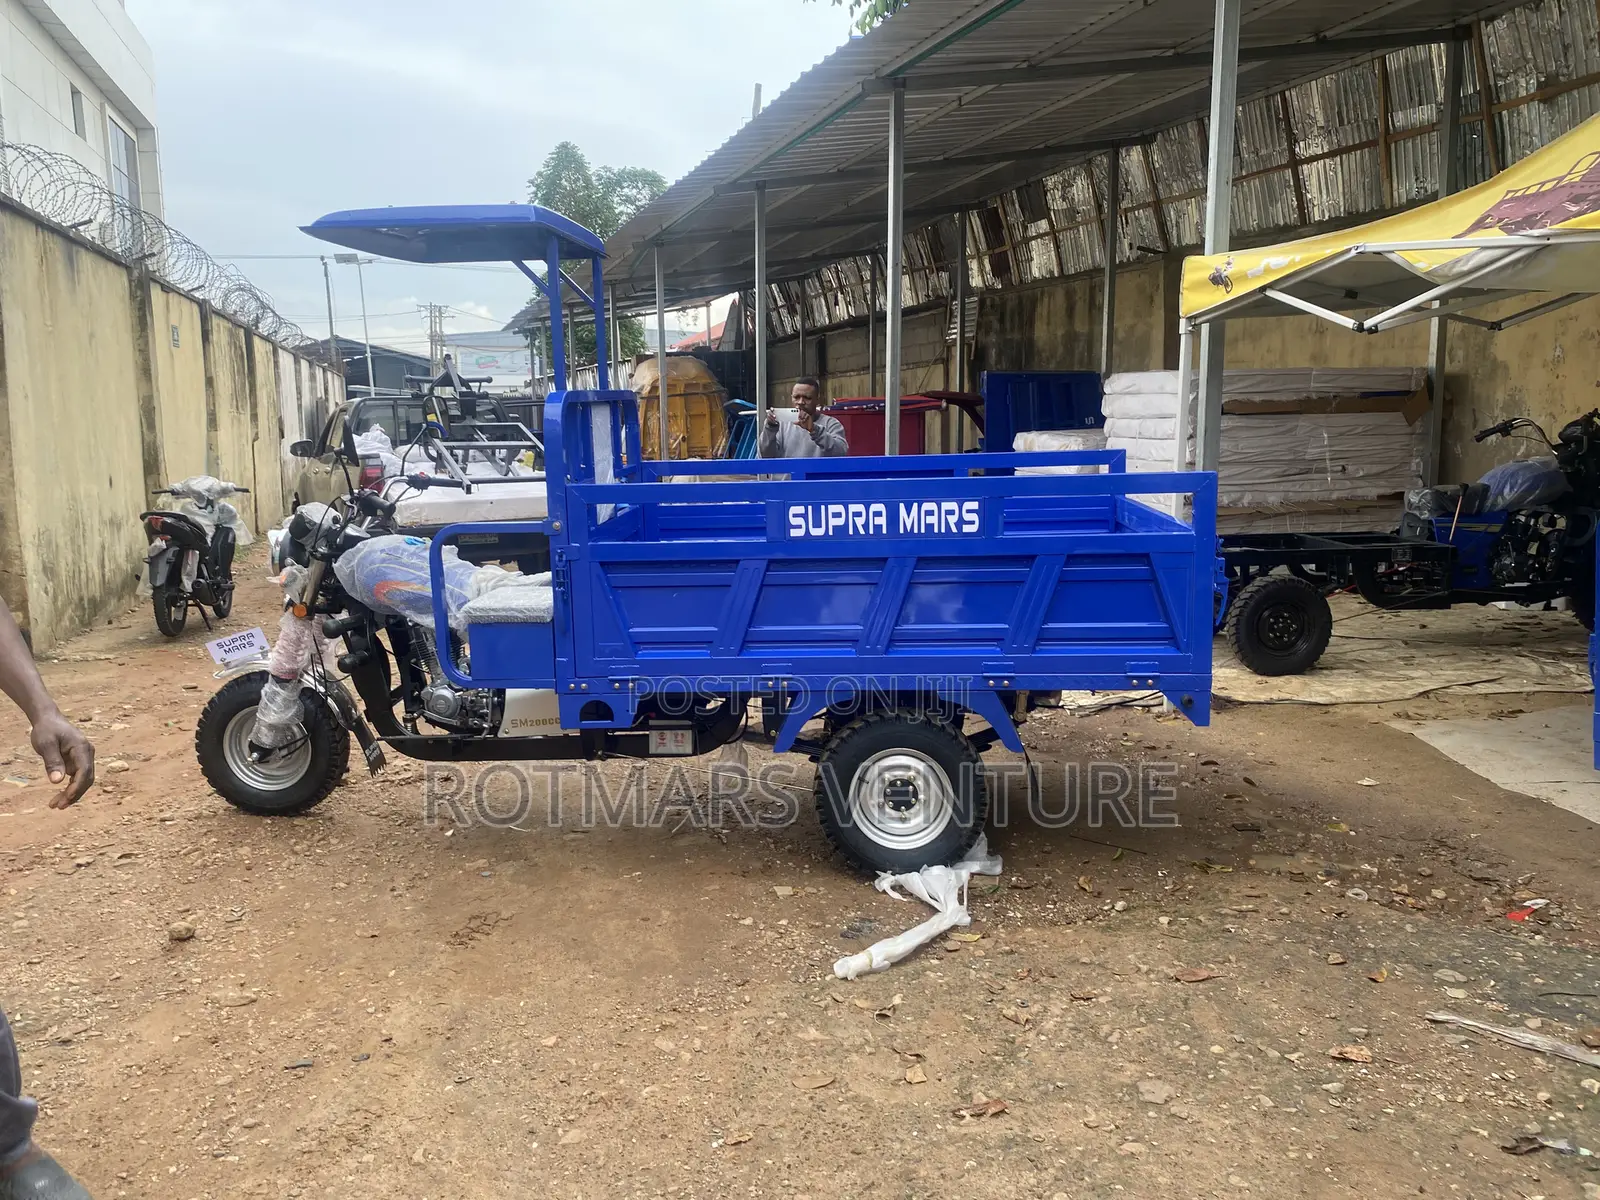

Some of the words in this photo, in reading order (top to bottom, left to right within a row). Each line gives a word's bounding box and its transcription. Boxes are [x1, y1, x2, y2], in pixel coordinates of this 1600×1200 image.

[788, 503, 887, 537] SUPRA
[899, 501, 979, 534] MARS
[216, 632, 255, 650] SUPRA
[223, 640, 255, 655] MARS
